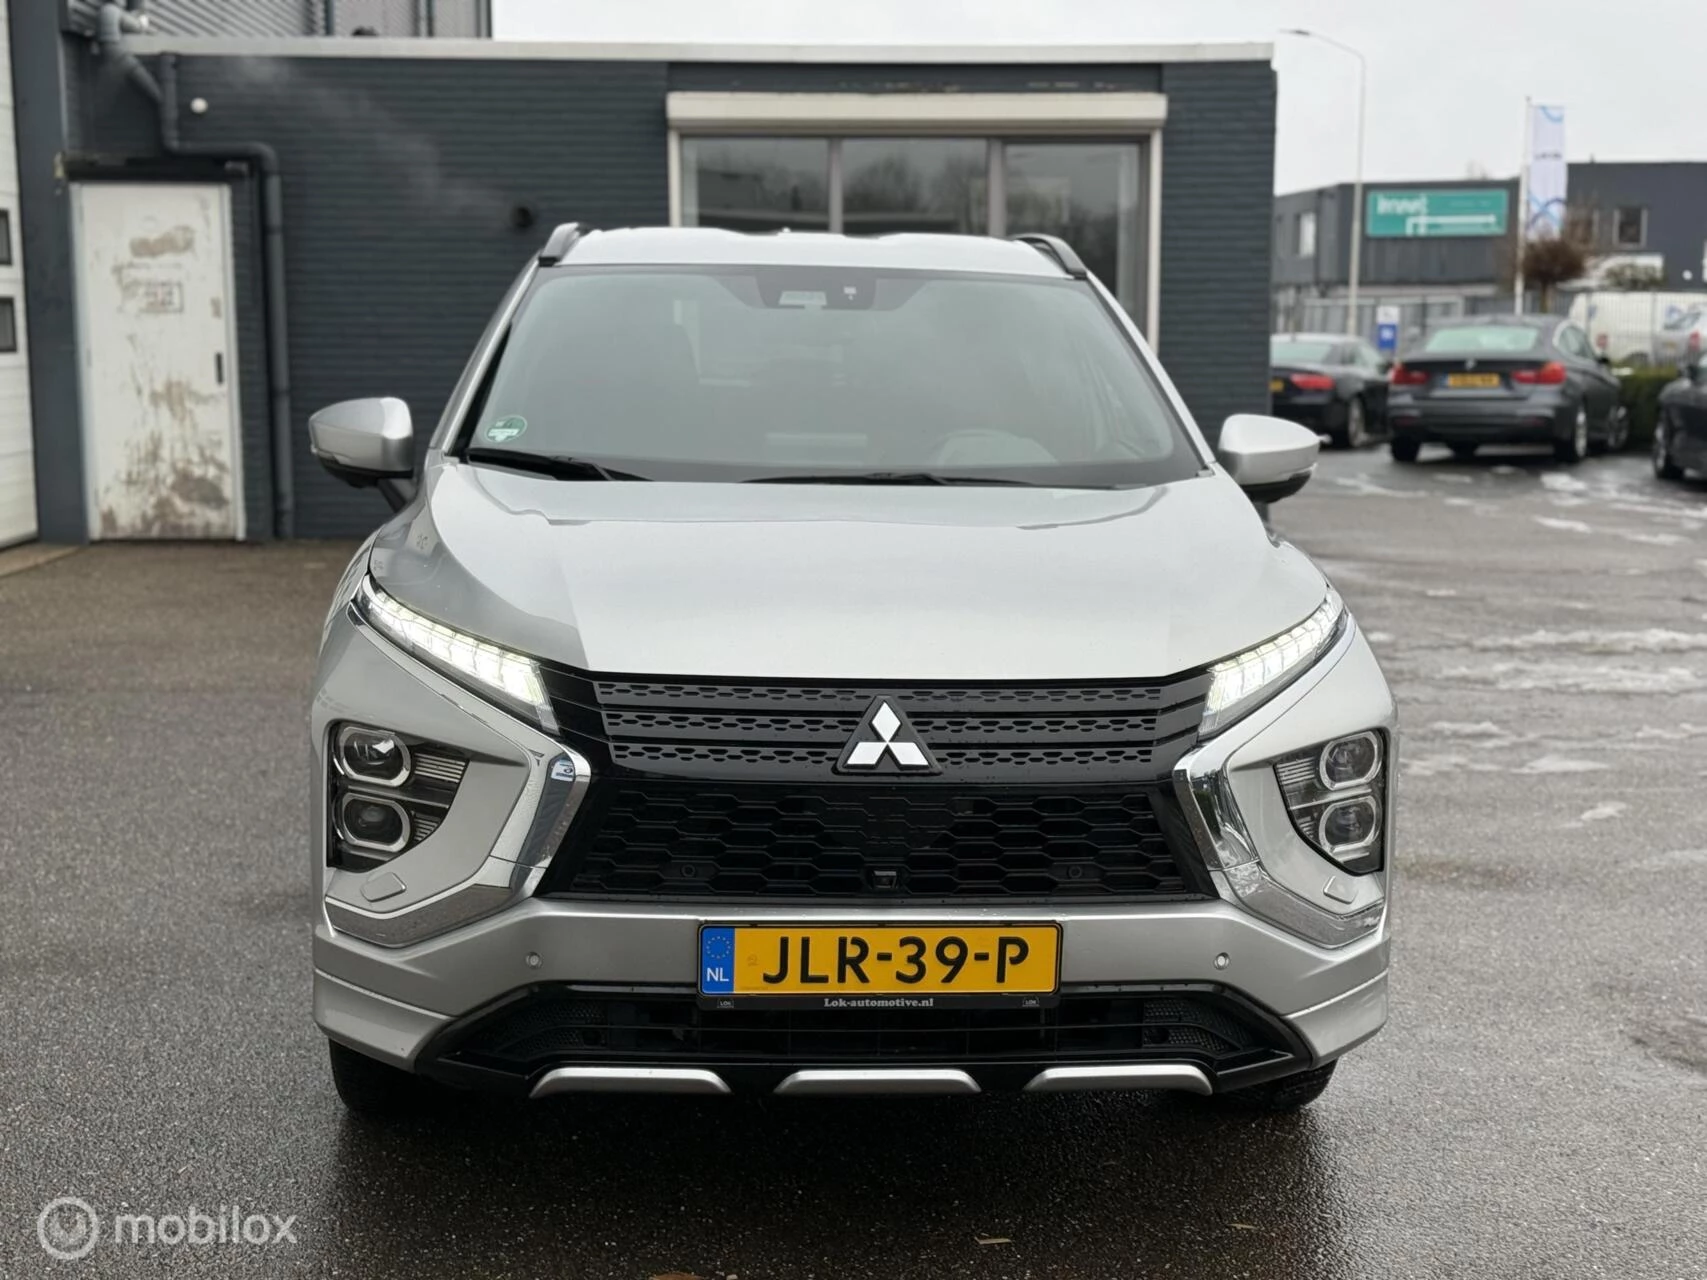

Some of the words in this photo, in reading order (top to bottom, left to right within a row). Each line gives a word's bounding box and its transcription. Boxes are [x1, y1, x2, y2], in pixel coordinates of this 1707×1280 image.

[762, 935, 1030, 985] JLR-39-P
[706, 967, 730, 983] NL
[823, 998, 934, 1008] Lok-automotive.nl
